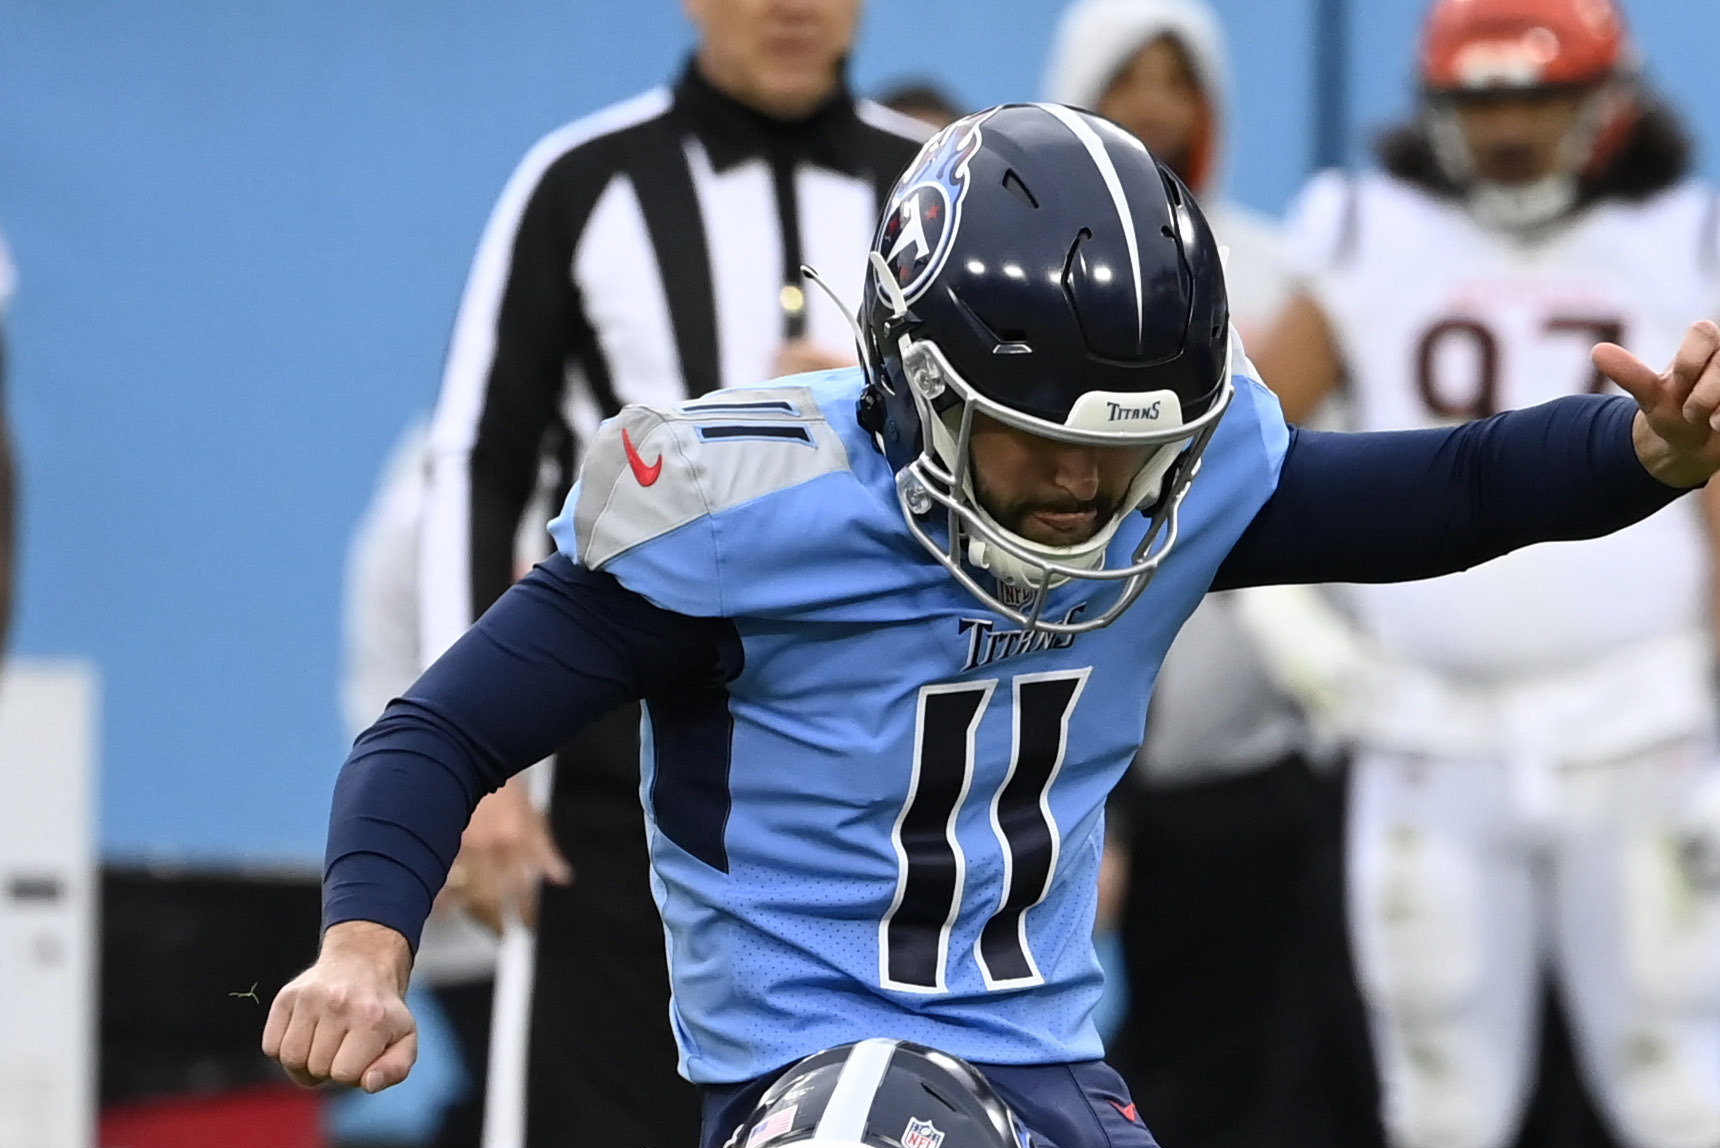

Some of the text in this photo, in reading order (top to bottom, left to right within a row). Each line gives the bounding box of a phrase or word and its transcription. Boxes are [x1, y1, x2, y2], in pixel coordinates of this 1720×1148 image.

[1412, 314, 1623, 418] 97
[1106, 400, 1161, 421] TITANS
[958, 601, 1087, 674] TITANS
[878, 666, 1093, 994] 11
